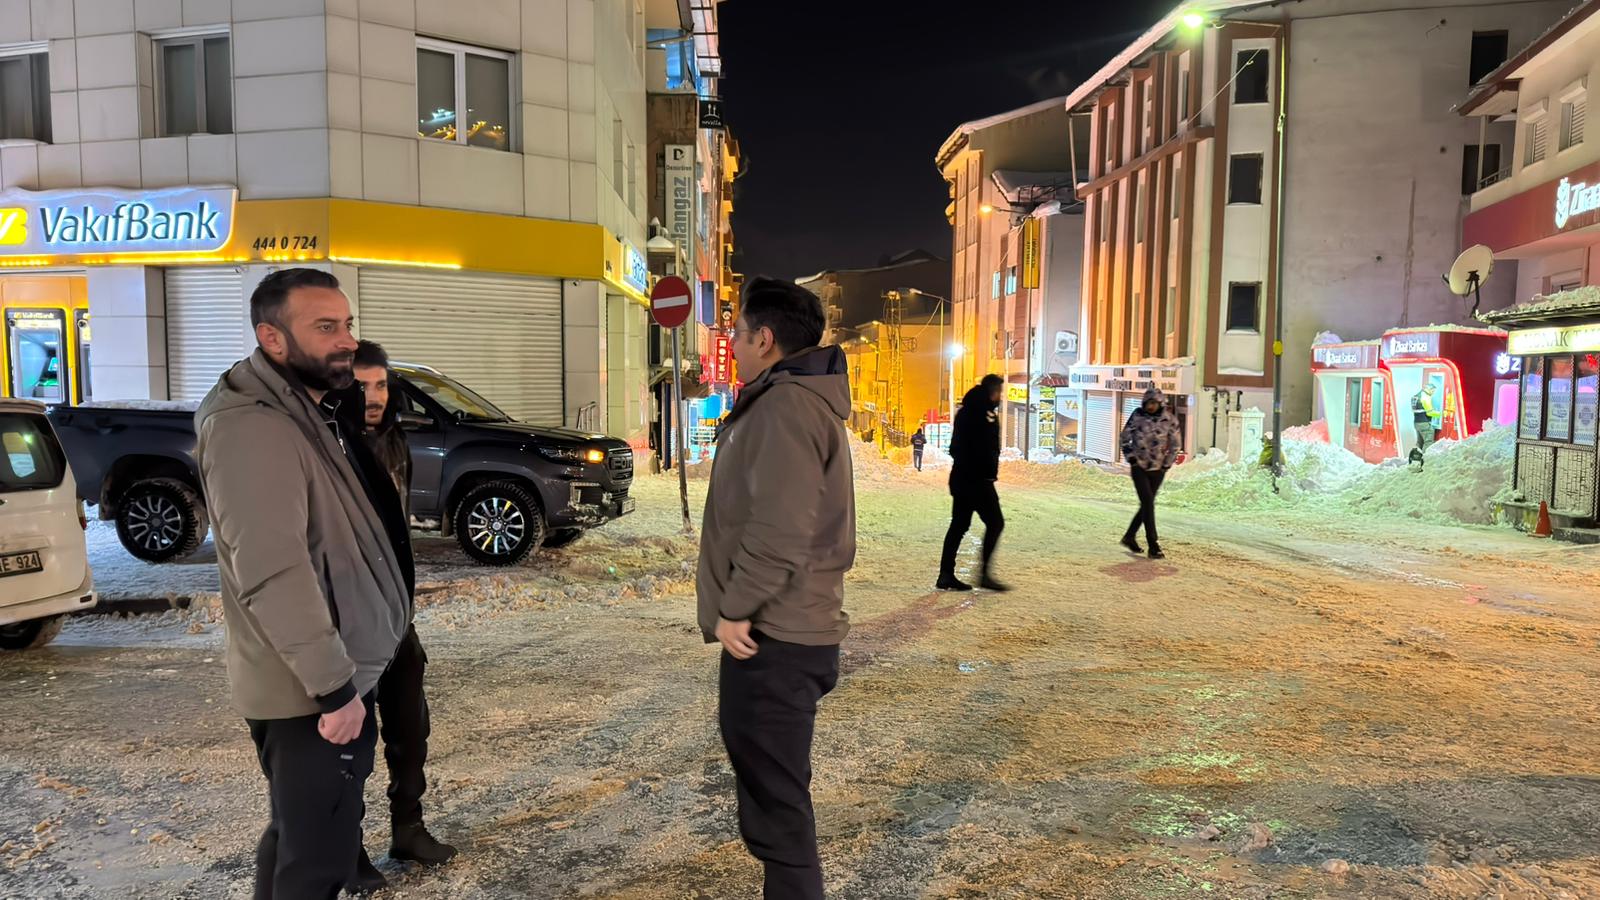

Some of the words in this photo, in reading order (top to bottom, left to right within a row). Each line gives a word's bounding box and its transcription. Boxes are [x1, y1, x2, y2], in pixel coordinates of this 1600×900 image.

[39, 201, 220, 243] VakıfBank
[252, 237, 276, 250] 444
[281, 236, 288, 249] 0
[293, 235, 317, 249] 724
[719, 340, 727, 380] HOTEL
[0, 557, 11, 572] E
[16, 553, 38, 569] 924
